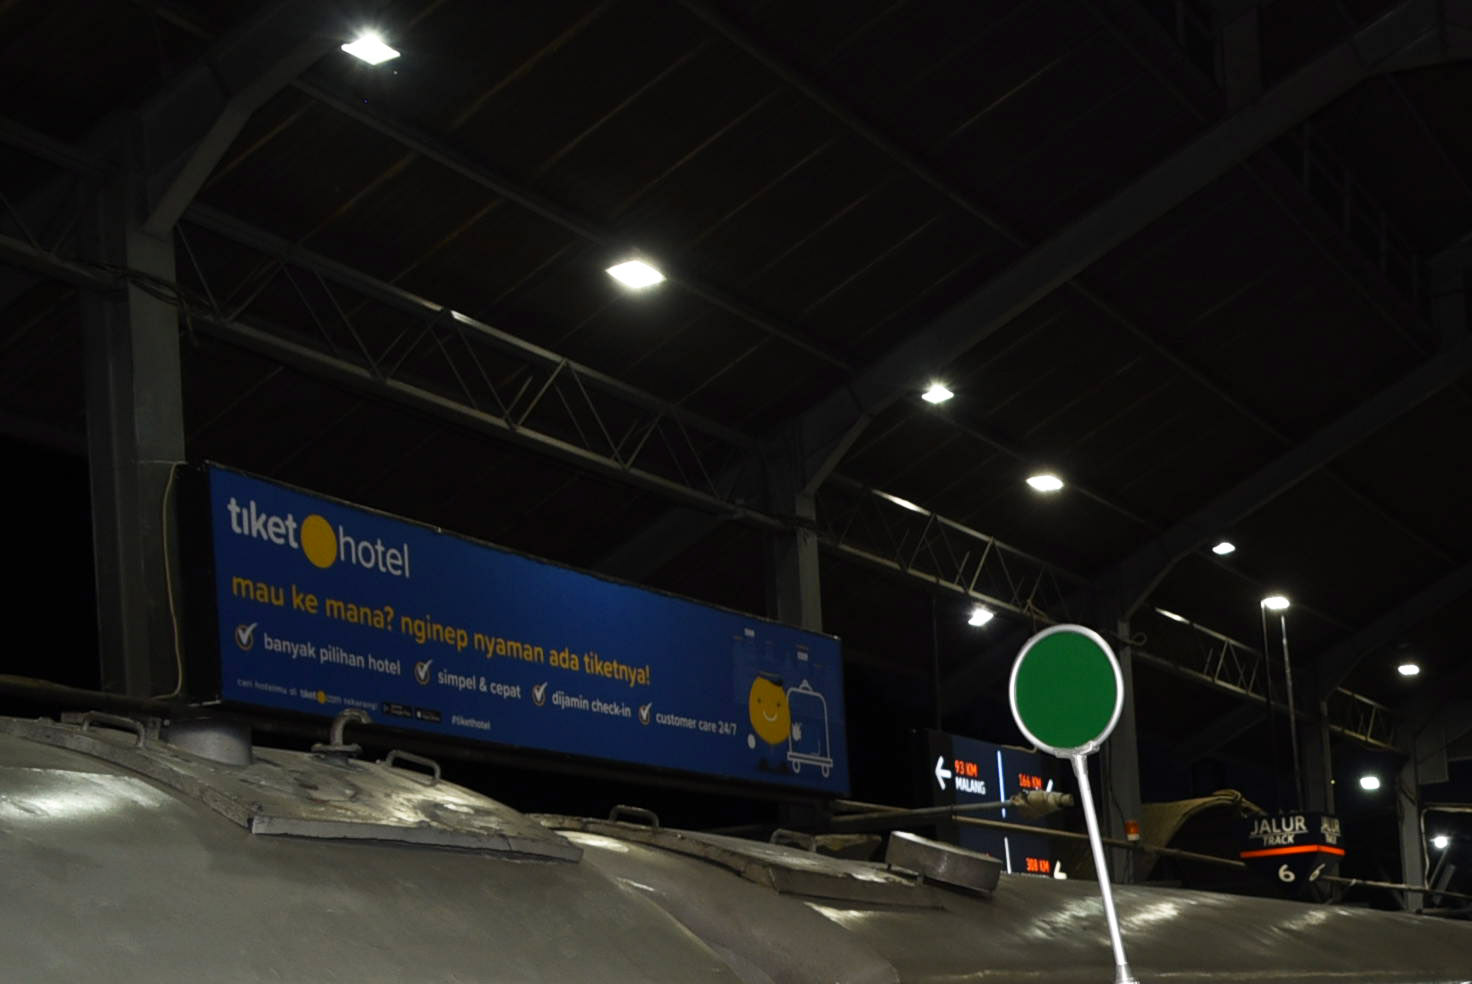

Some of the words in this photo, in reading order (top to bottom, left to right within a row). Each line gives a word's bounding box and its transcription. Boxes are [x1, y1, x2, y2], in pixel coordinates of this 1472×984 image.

[227, 497, 299, 549] tiket
[339, 525, 411, 579] hotel
[231, 575, 285, 607] mau
[292, 585, 319, 614] ke
[325, 597, 395, 631] mana?
[400, 614, 469, 652] nginep
[473, 631, 544, 664] nyaman
[549, 649, 580, 672] ada
[583, 653, 651, 688] tiketnya!
[263, 633, 316, 660] banyak
[319, 645, 366, 671] pilihan
[367, 655, 401, 676] hotel
[437, 669, 477, 692] simpel
[478, 676, 488, 693] &
[489, 681, 522, 700] cepat
[552, 690, 590, 712] dijamin
[591, 699, 632, 718] check-in
[655, 711, 697, 731] customer
[698, 718, 718, 732] care
[955, 776, 986, 795] MALANG
[1250, 815, 1308, 836] JALUR
[1278, 863, 1296, 882] 6
